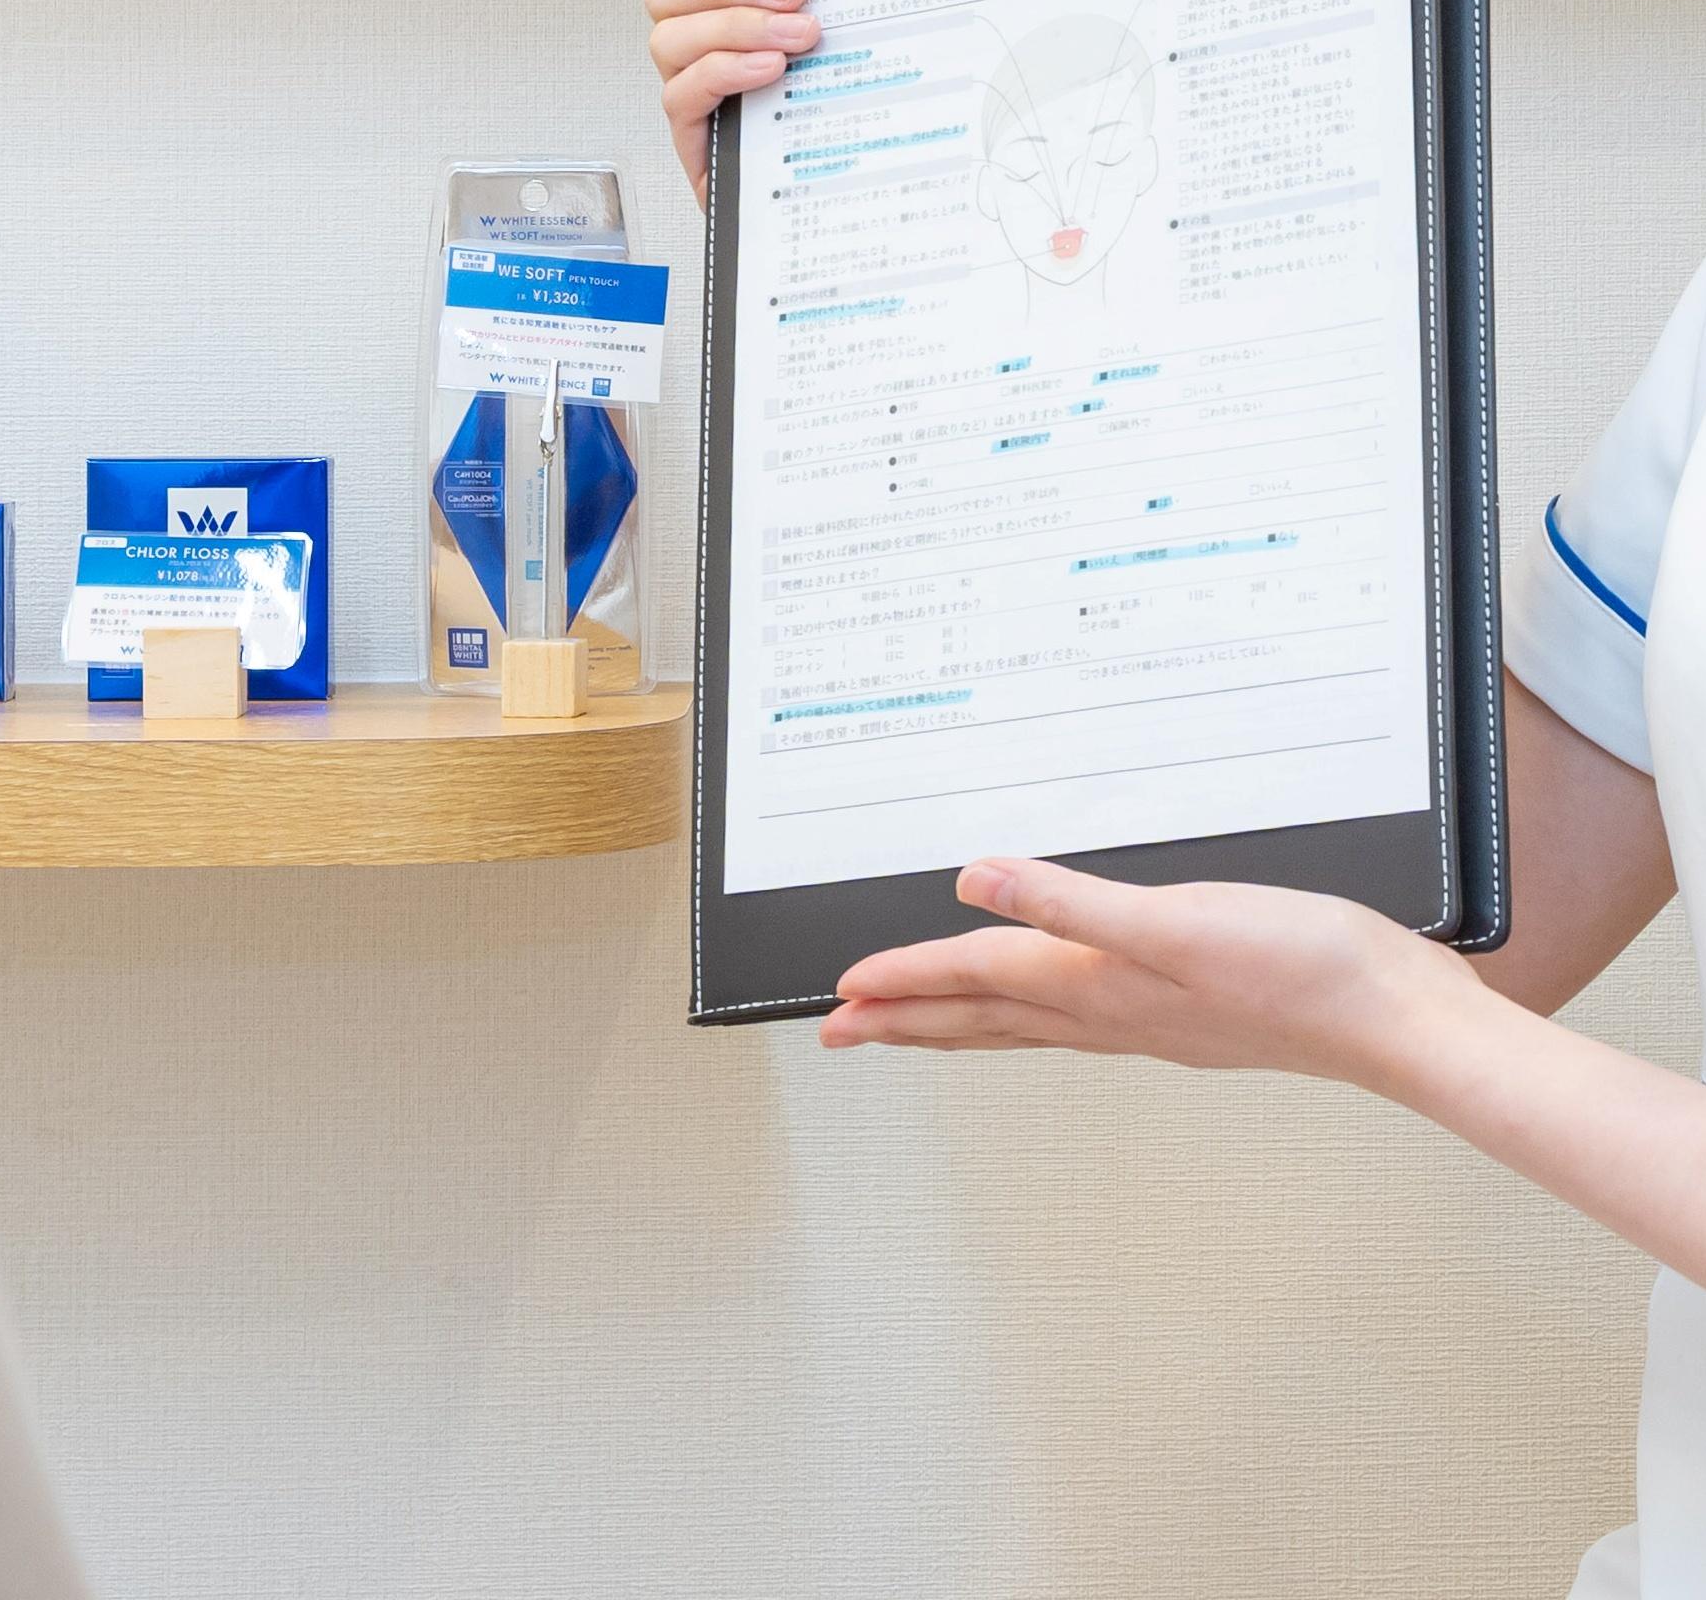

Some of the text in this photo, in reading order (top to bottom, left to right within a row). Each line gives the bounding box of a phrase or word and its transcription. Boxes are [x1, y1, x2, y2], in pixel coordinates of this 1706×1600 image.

[501, 215, 536, 226] WHITE
[540, 215, 590, 226] ESSENCE
[490, 231, 507, 241] WE
[510, 231, 540, 241] SOFT
[556, 233, 583, 242] TOUCH
[497, 264, 621, 288] WE SOFT PEN TOUCH
[532, 289, 580, 305] ¥1,320
[507, 374, 540, 387] WHITE
[125, 546, 230, 560] CHLOR FLOSS
[452, 644, 484, 652] DENTAL
[453, 651, 484, 661] WHITE
